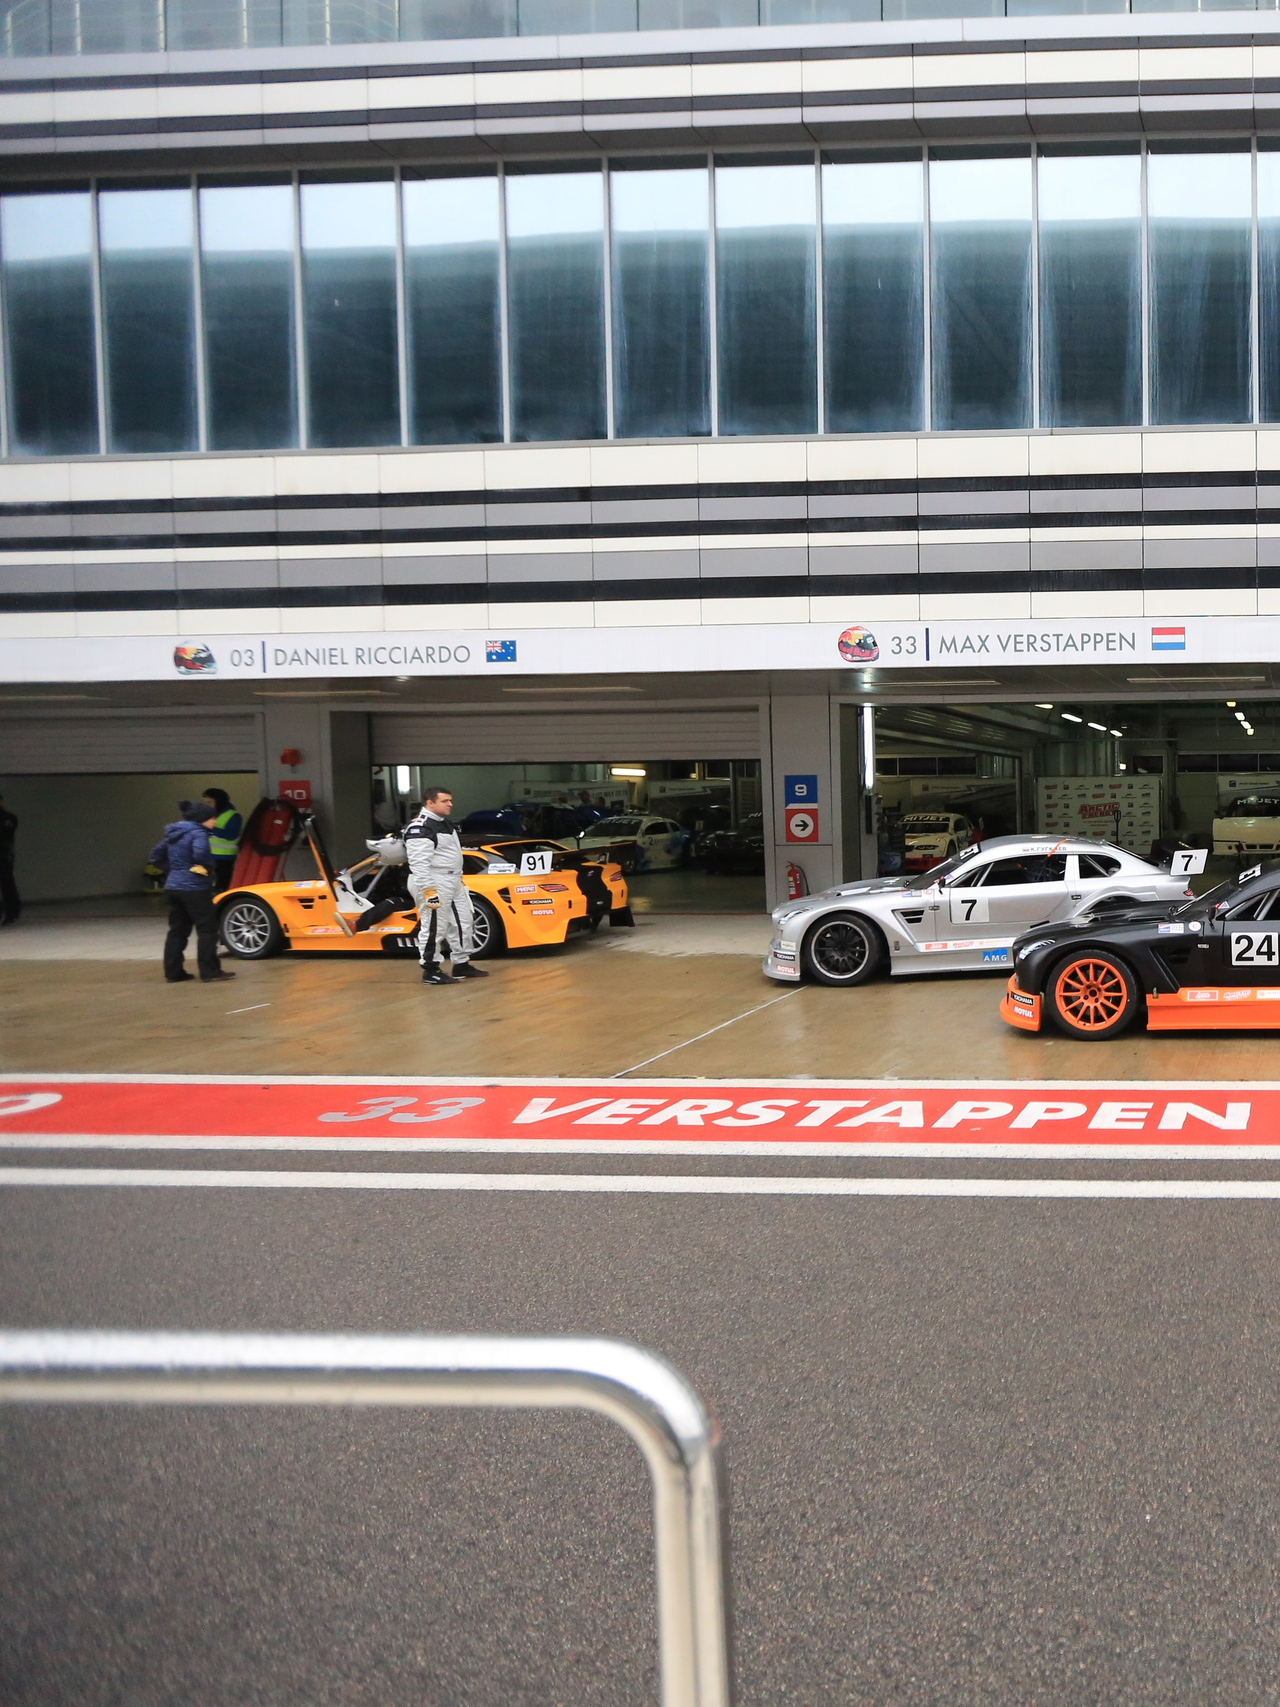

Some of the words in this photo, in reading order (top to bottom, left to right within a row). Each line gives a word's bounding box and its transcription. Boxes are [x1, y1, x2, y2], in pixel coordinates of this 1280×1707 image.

[890, 636, 917, 655] 33
[938, 634, 990, 654] MAX
[997, 632, 1136, 653] VERSTAPPEN
[230, 648, 255, 667] 03
[274, 647, 349, 666] DANIEL
[355, 645, 471, 665] RICCIARDO
[794, 784, 807, 796] 9
[526, 854, 546, 871] 91
[1181, 854, 1194, 872] 7
[961, 899, 977, 921] 7
[1235, 934, 1276, 961] 24
[983, 954, 1007, 962] AMG
[1014, 1005, 1034, 1018] MOTUL
[317, 1096, 486, 1124] 33
[512, 1097, 1252, 1131] VERSTAPPEN
